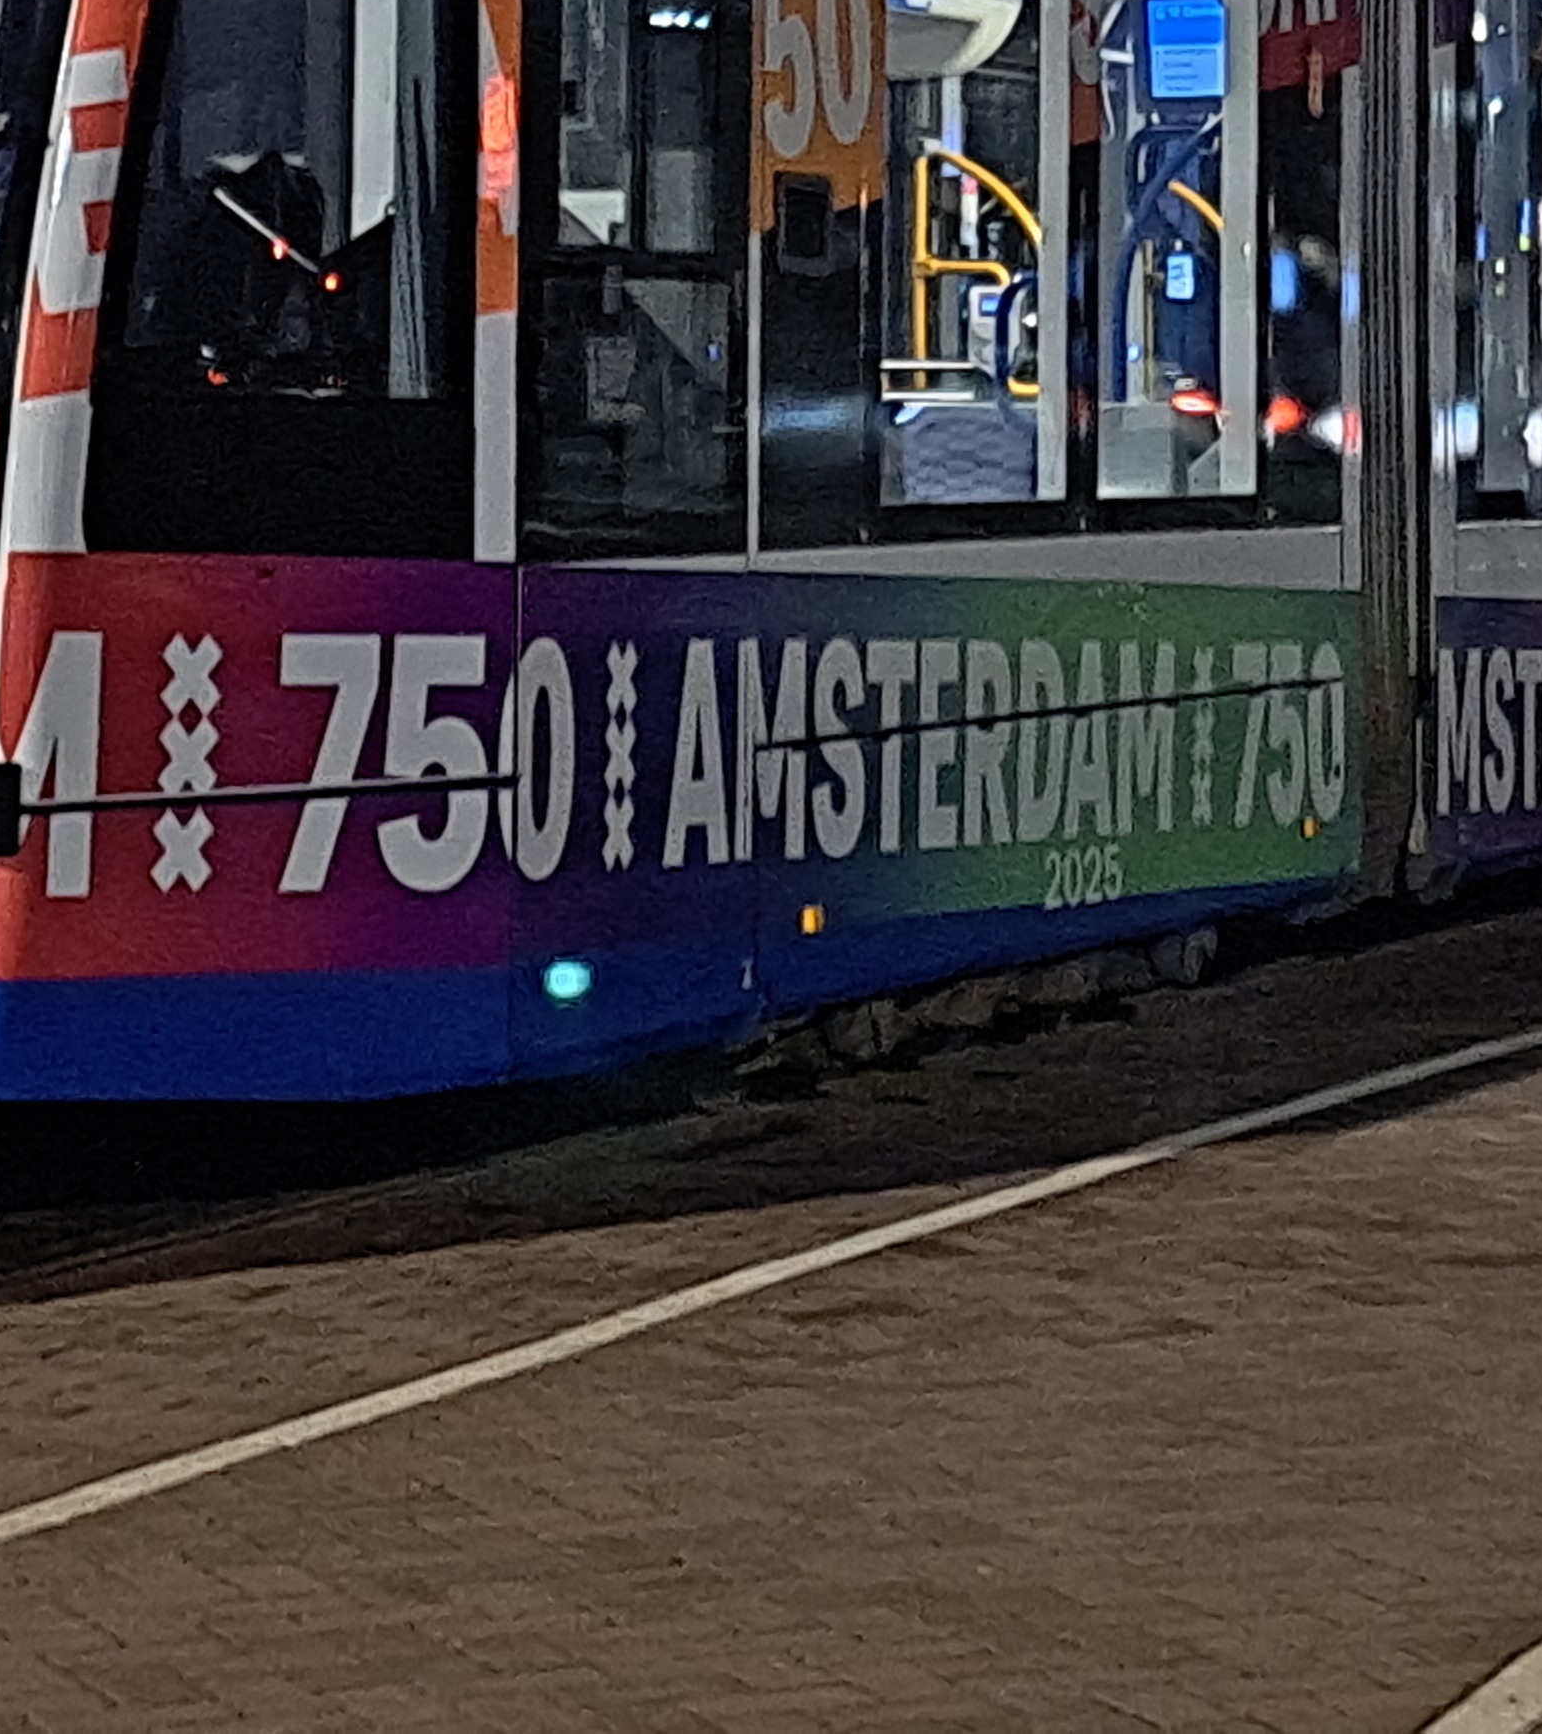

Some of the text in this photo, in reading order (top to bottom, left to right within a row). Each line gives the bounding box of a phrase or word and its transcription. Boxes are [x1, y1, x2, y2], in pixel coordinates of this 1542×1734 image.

[279, 631, 574, 895] 750
[661, 637, 1175, 870] AMSTERDAM
[1231, 641, 1347, 832] 750
[1043, 854, 1124, 914] 2025
